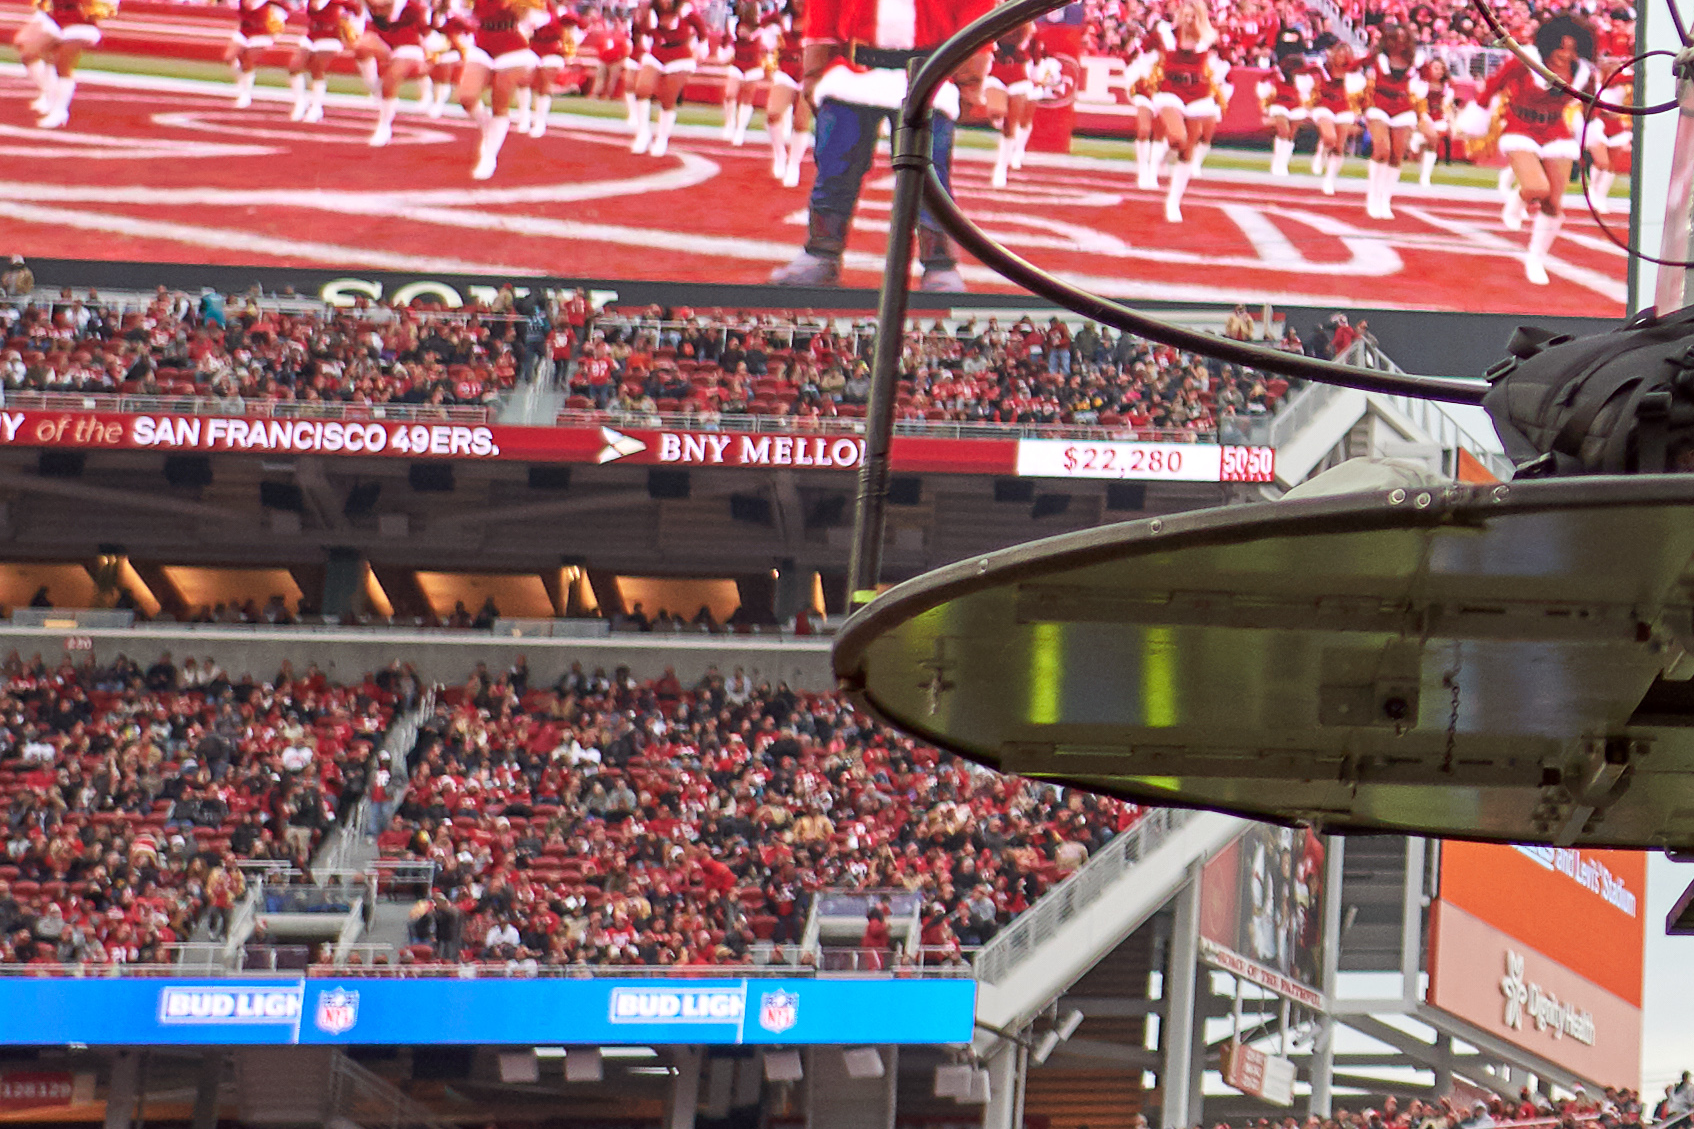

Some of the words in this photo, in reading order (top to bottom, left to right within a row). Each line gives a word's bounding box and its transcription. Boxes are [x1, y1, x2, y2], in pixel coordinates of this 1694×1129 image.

[0, 412, 26, 442] Y
[36, 414, 72, 442] of
[74, 415, 124, 444] the
[133, 415, 201, 446] SAN
[206, 418, 387, 453] FRANCISCO
[391, 423, 500, 457] 49ERS.
[659, 432, 732, 464] BNY
[1063, 444, 1183, 479] $22,280
[167, 991, 236, 1019] BUD
[616, 993, 682, 1017] BUD
[1526, 981, 1565, 1041] Dignity
